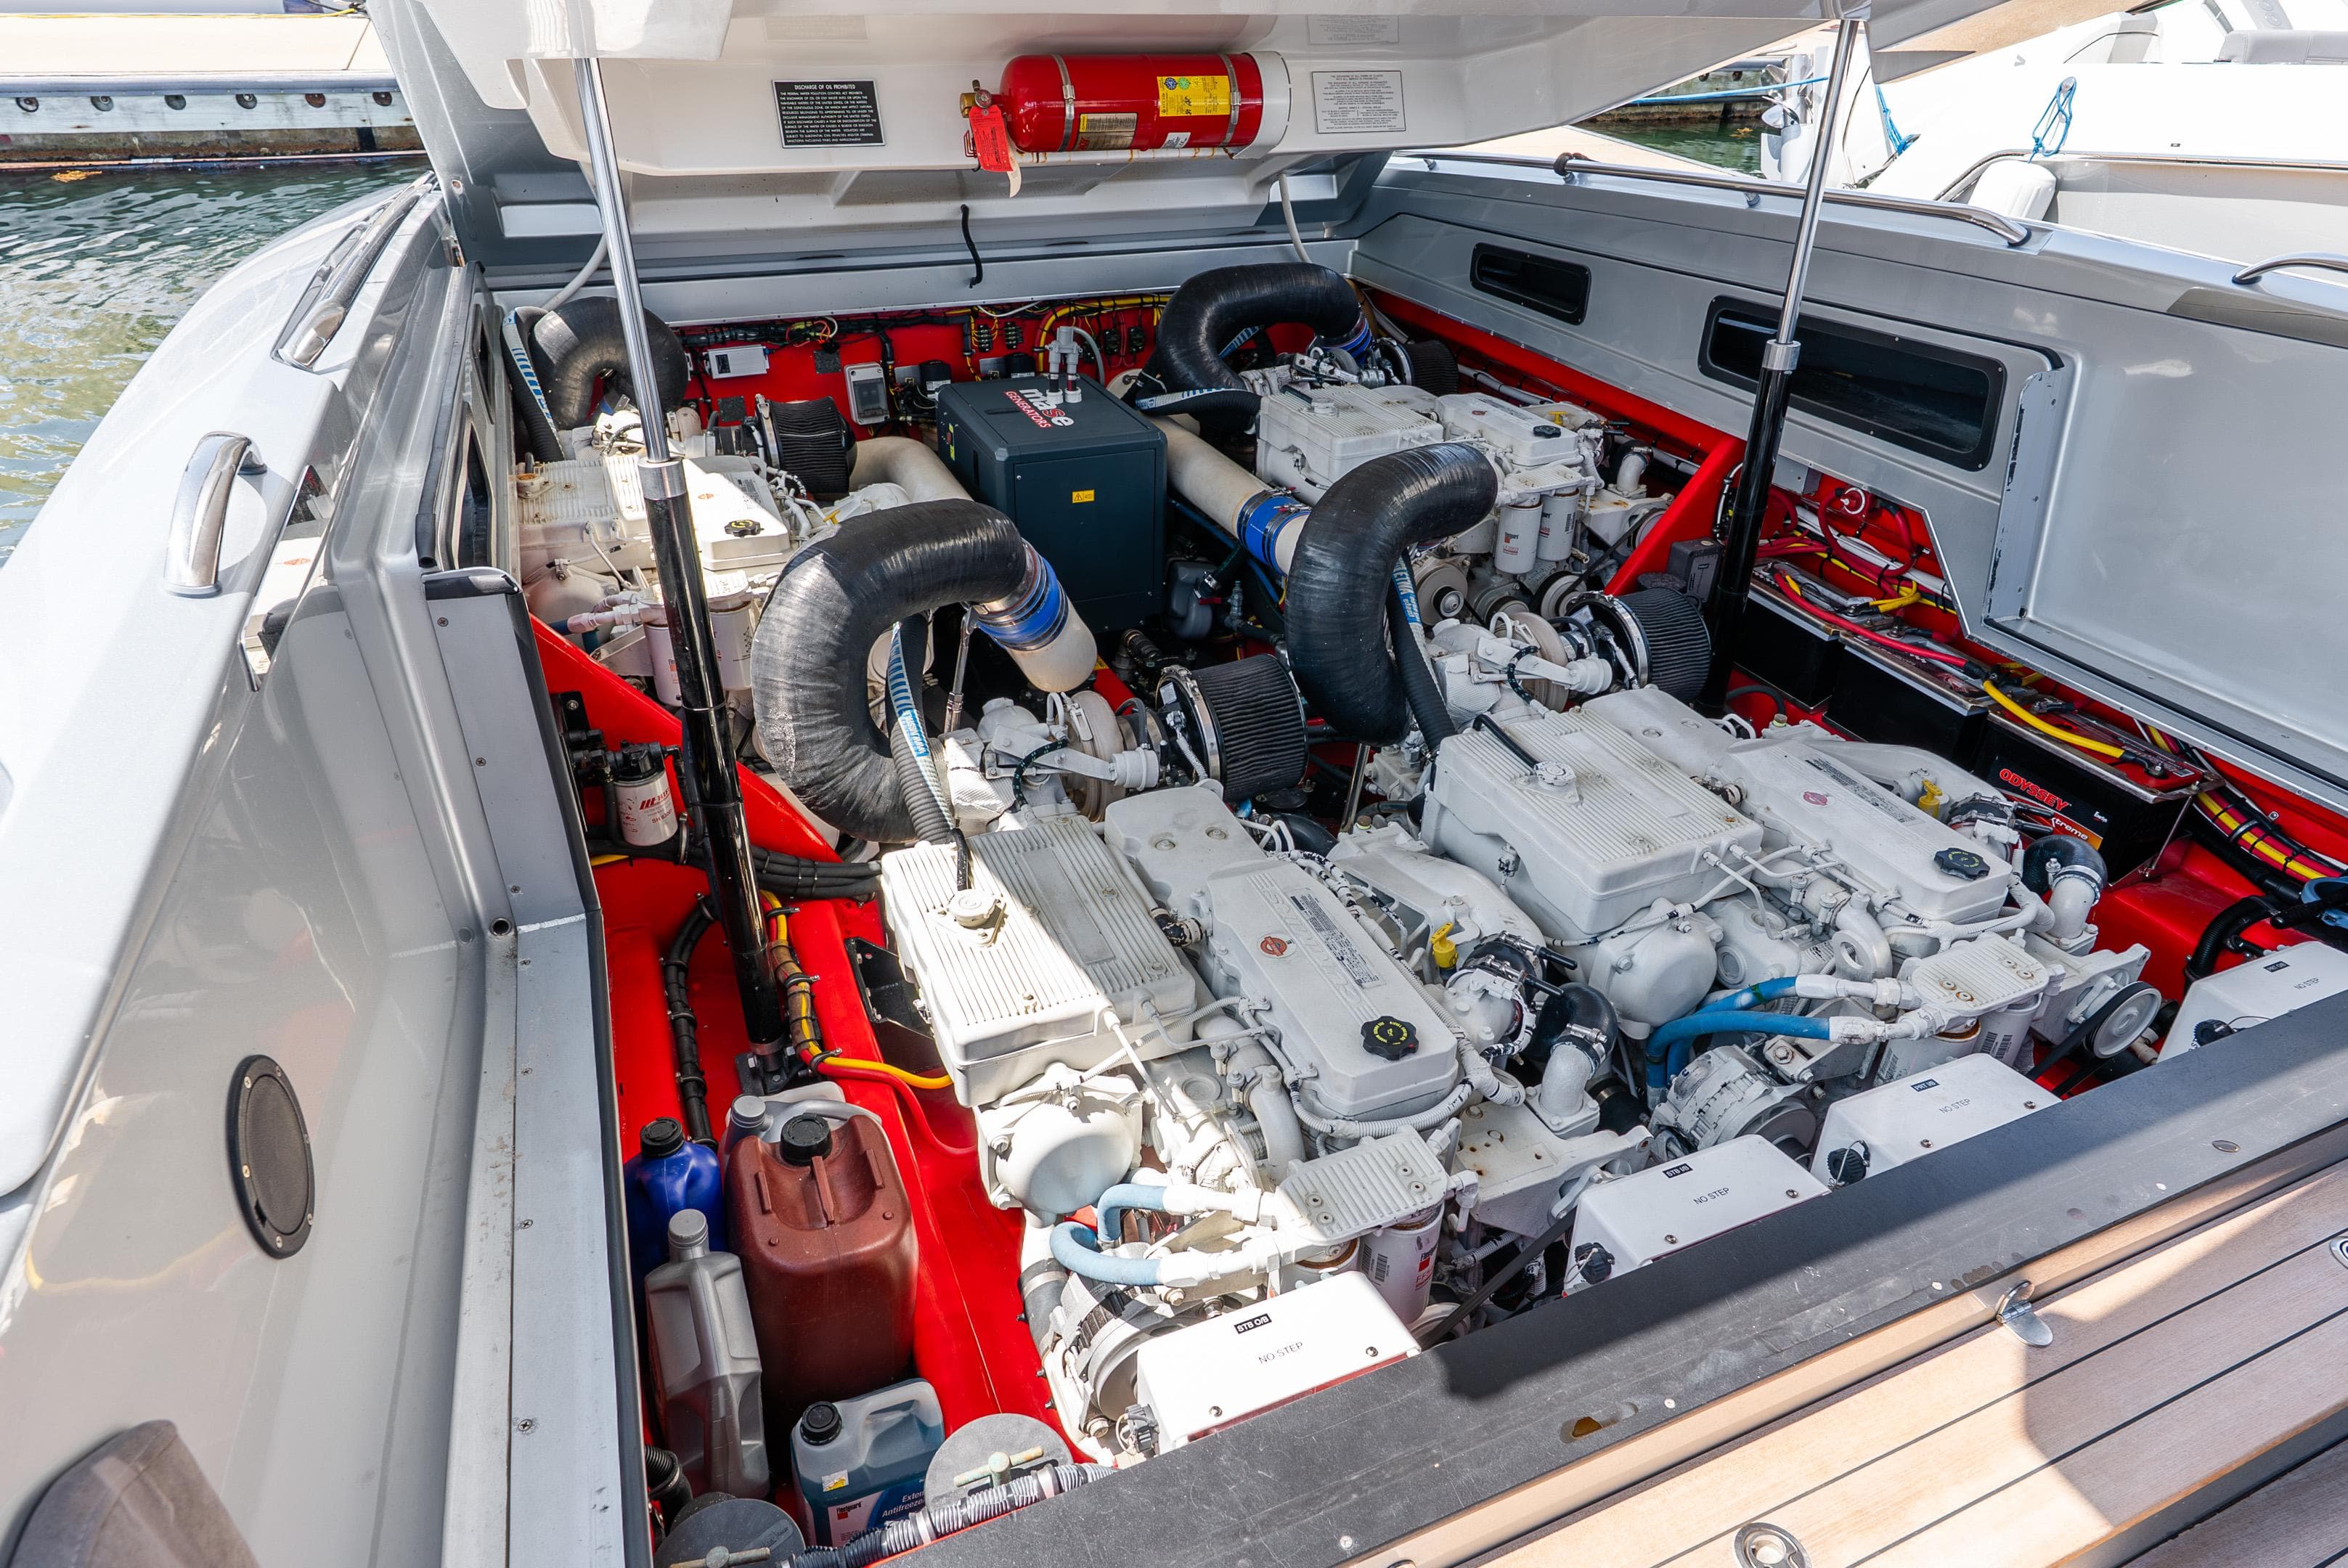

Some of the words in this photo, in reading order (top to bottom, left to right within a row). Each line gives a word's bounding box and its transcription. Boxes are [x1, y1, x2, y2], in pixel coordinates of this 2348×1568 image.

[1006, 391, 1051, 428] GENERATORS
[1019, 388, 1075, 426] mase
[1999, 768, 2069, 812] ODYSSEY
[2303, 977, 2320, 987] STEP
[1939, 1106, 1953, 1114] NO
[1951, 1098, 1970, 1109] STEP
[1666, 1168, 1680, 1177] STB
[1693, 1196, 1708, 1205] NO
[1708, 1187, 1729, 1199] STEP
[1236, 1321, 1254, 1332] STB
[1254, 1315, 1269, 1326] O/B
[1258, 1353, 1275, 1364] NO
[1276, 1342, 1303, 1357] STEP
[836, 1501, 862, 1513] Fleetguard
